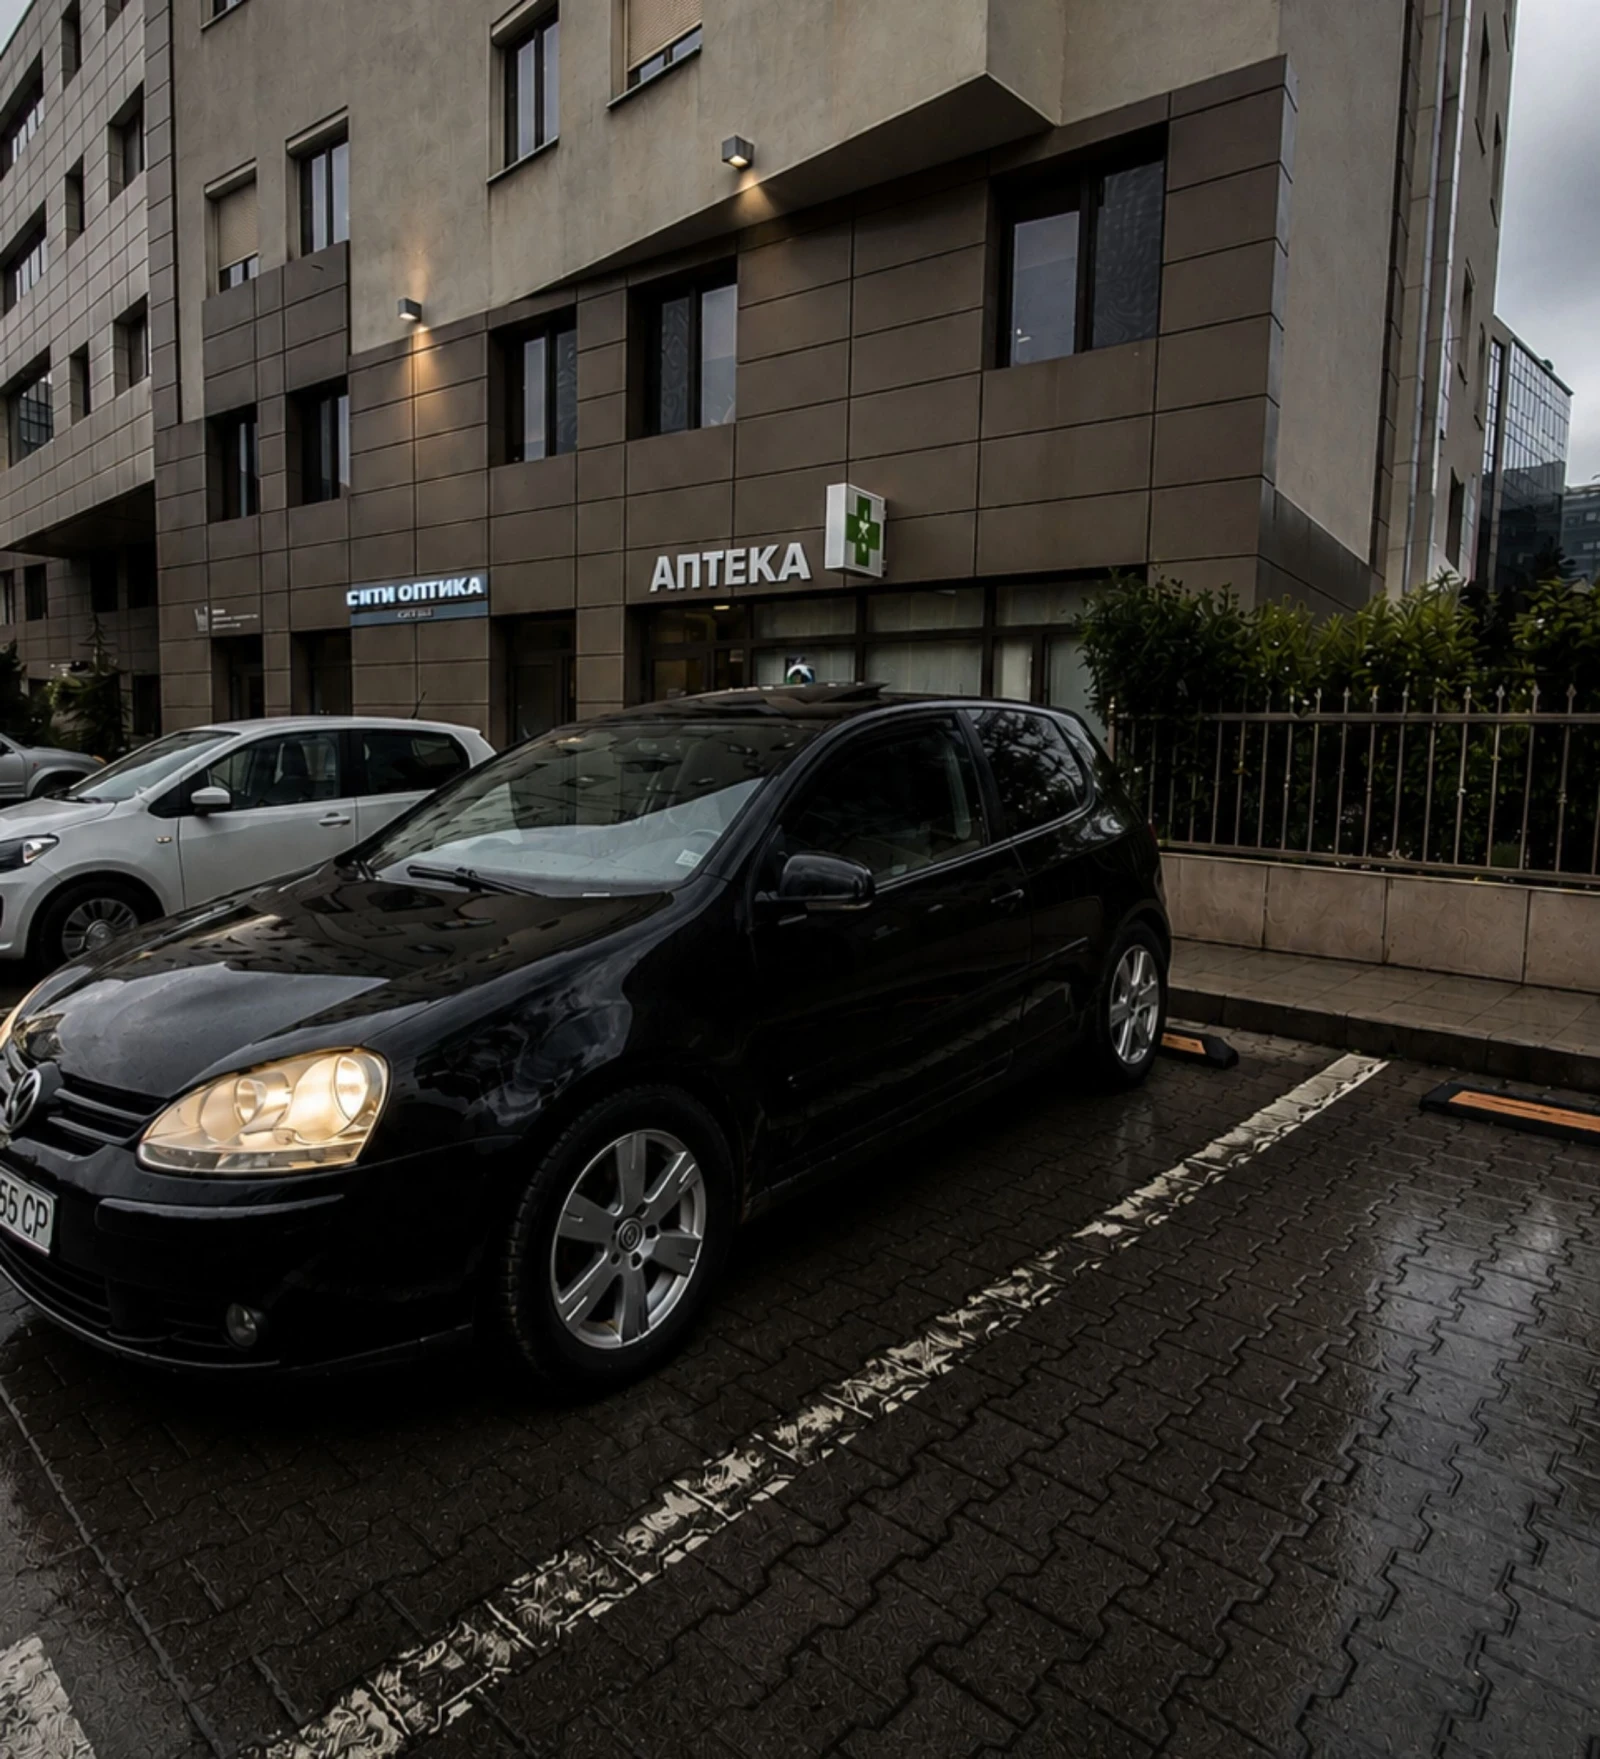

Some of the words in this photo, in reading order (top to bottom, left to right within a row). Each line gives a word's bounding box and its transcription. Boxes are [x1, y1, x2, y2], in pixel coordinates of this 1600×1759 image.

[397, 577, 483, 601] ОПТИКА
[650, 542, 811, 592] АПТЕКА
[22, 1193, 48, 1239] CP
